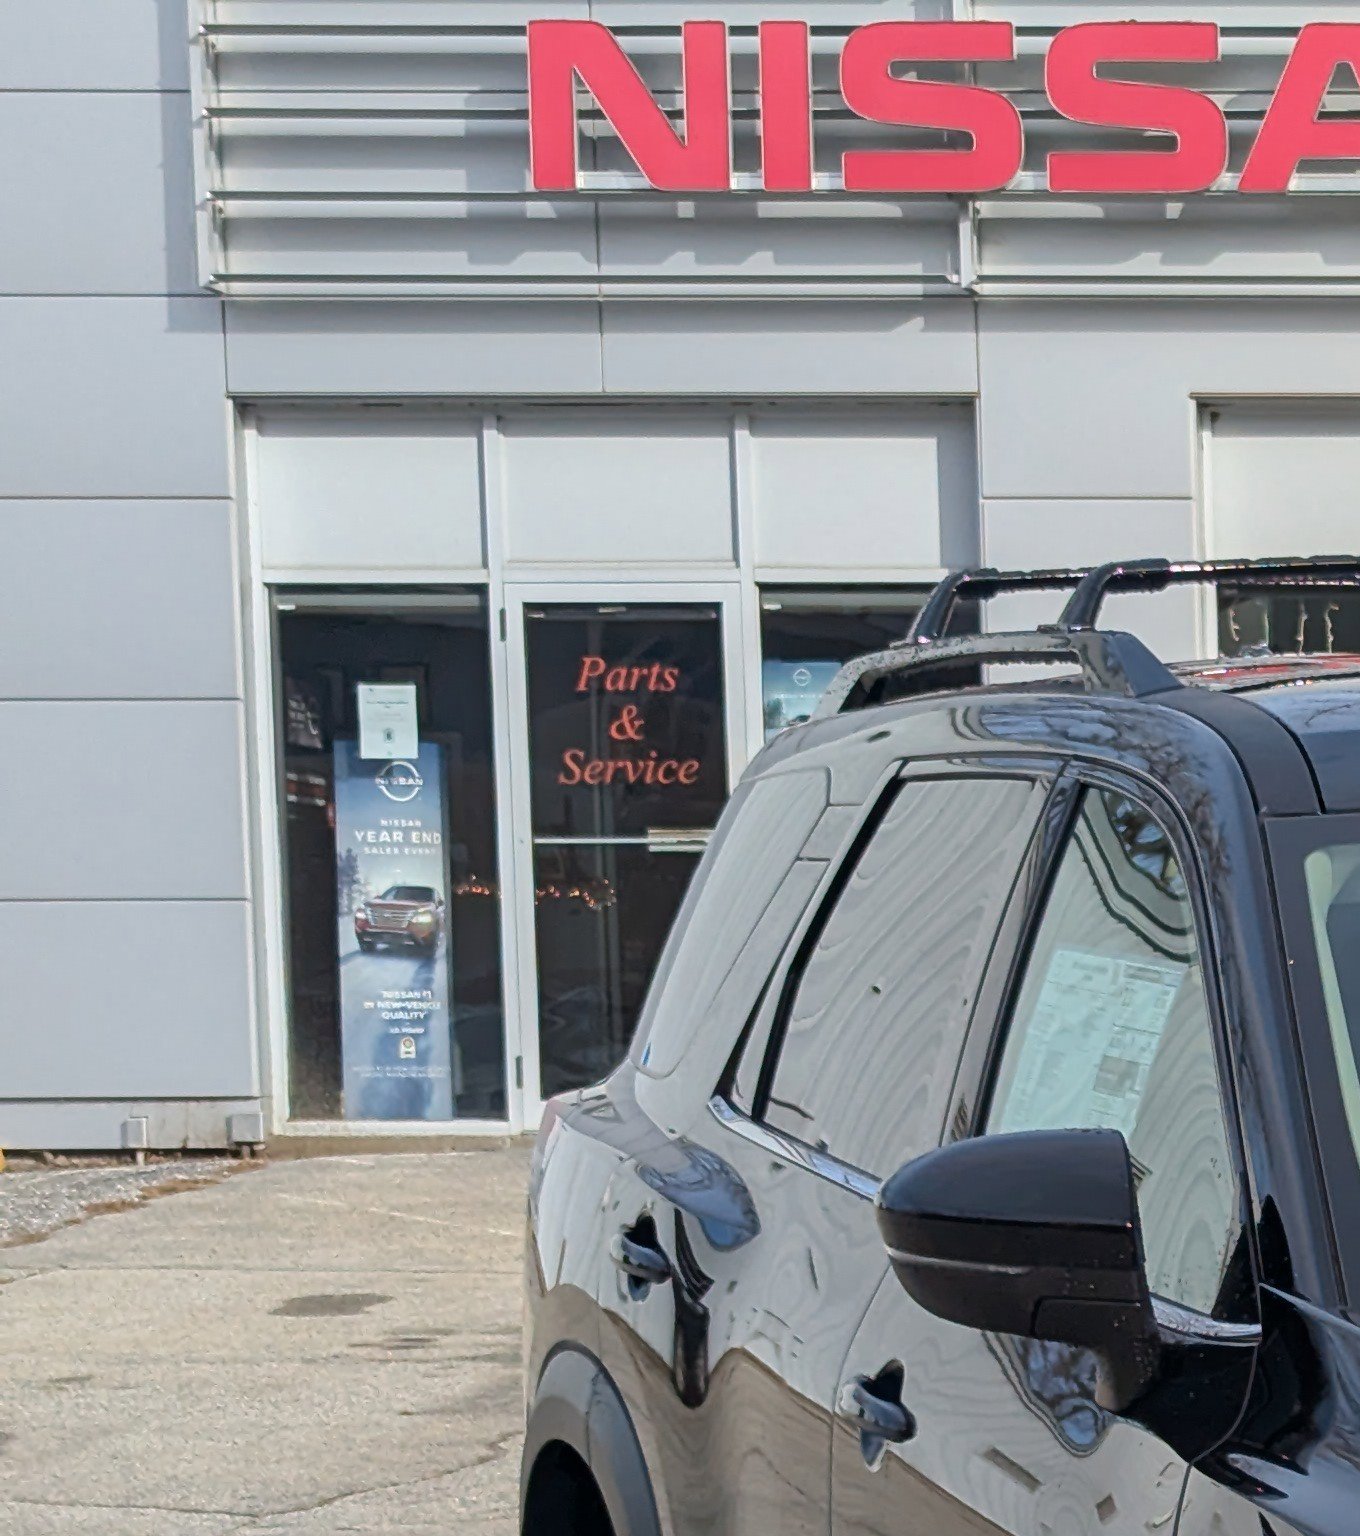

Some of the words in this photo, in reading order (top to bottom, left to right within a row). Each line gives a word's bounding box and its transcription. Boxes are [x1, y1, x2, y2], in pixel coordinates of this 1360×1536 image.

[576, 656, 680, 692] Parts
[608, 704, 645, 741] &
[557, 749, 700, 785] Service
[380, 819, 421, 827] NISSAN
[354, 830, 403, 843] YEAR
[411, 831, 441, 845] END
[381, 1011, 426, 1020] QUALITY
